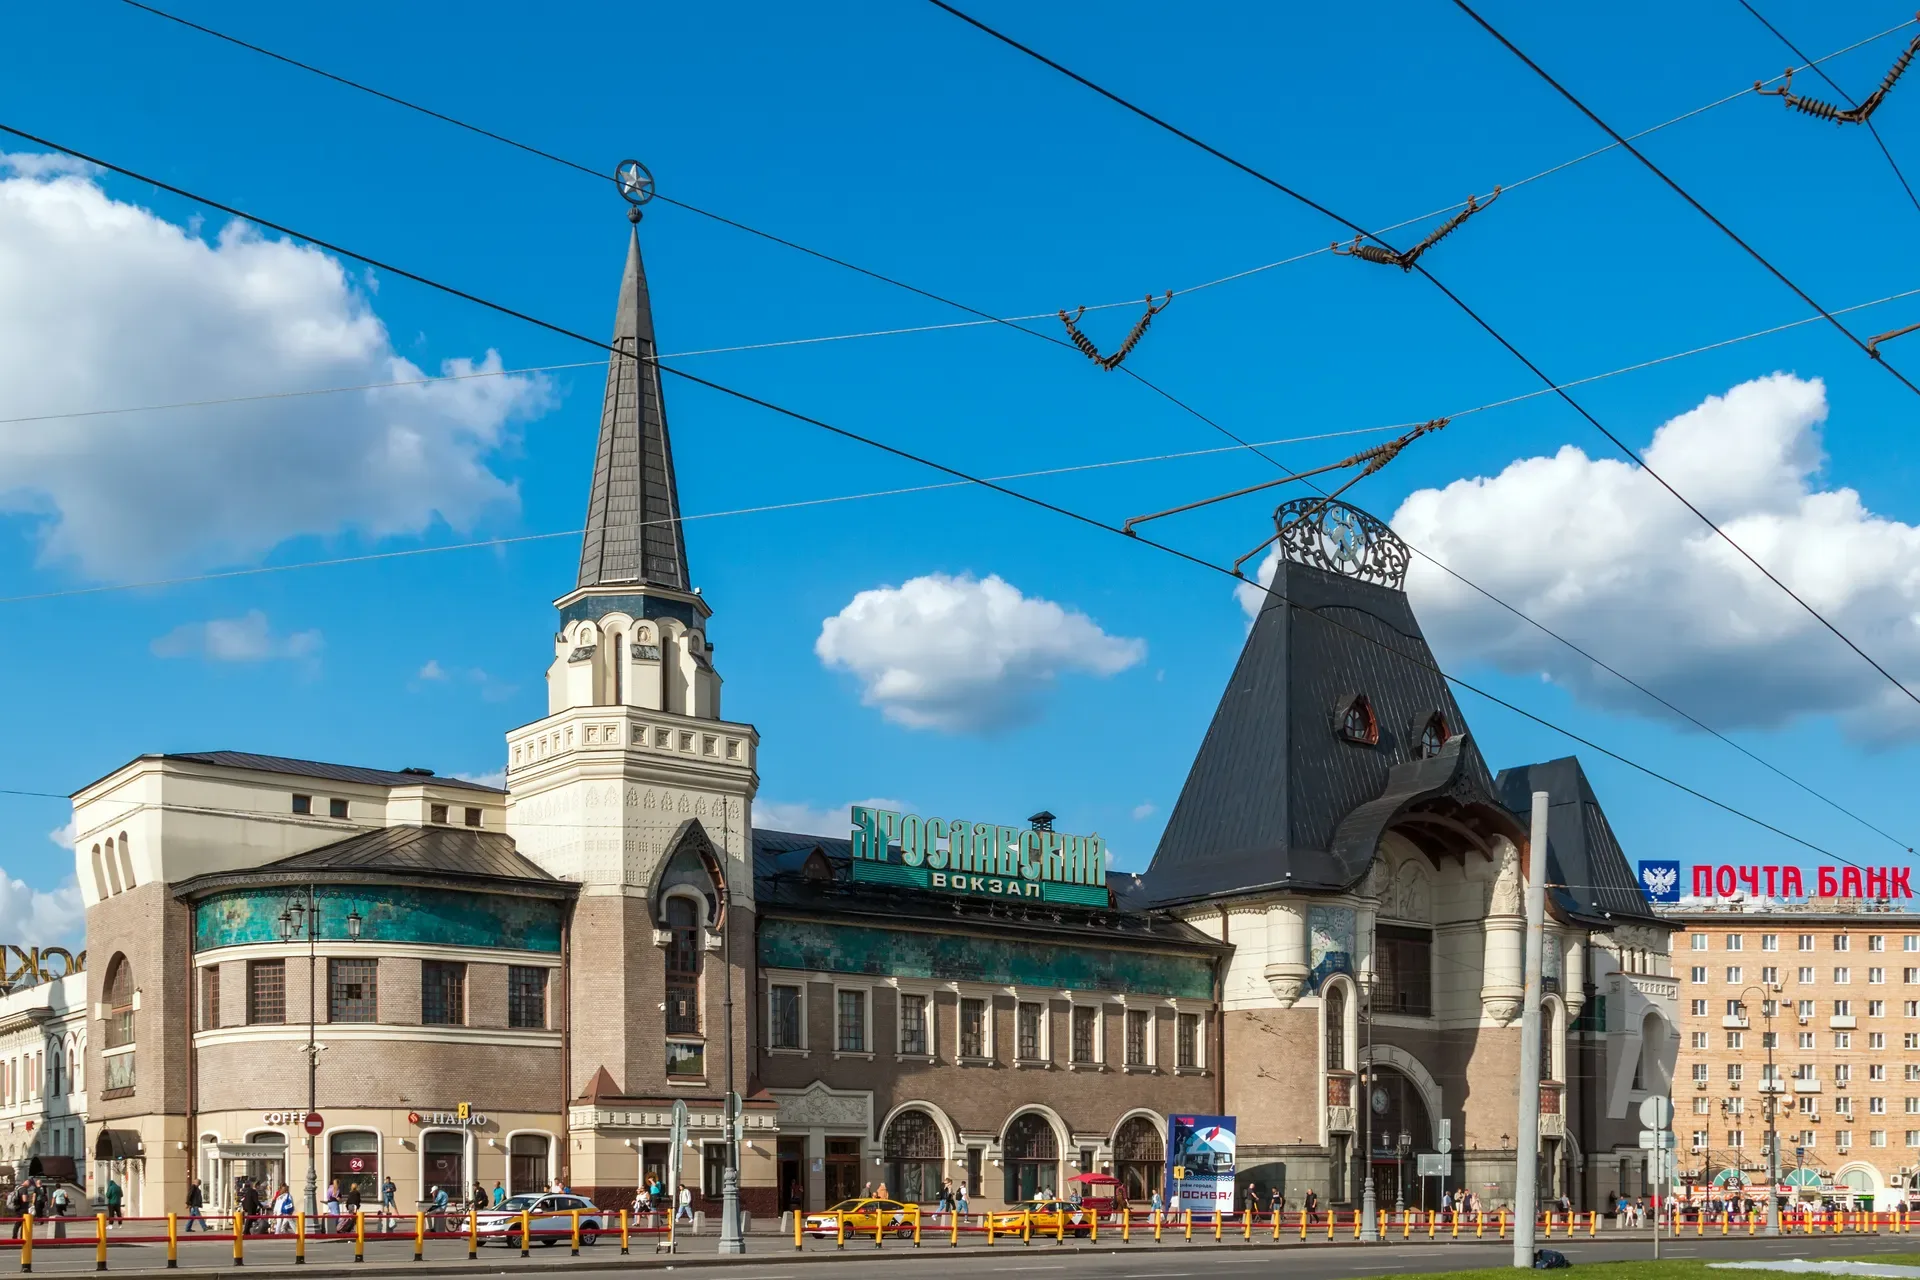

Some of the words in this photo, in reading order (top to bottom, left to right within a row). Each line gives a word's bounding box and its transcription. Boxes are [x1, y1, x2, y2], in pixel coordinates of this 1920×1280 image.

[851, 805, 1106, 886] ЯРОСЛАВСКИЙ
[931, 872, 1040, 898] ВОКЗАЛ
[1692, 865, 1804, 898] ПОЧТА
[1818, 866, 1914, 899] БАНК
[262, 1112, 307, 1124] COFFE
[351, 1160, 363, 1168] 24
